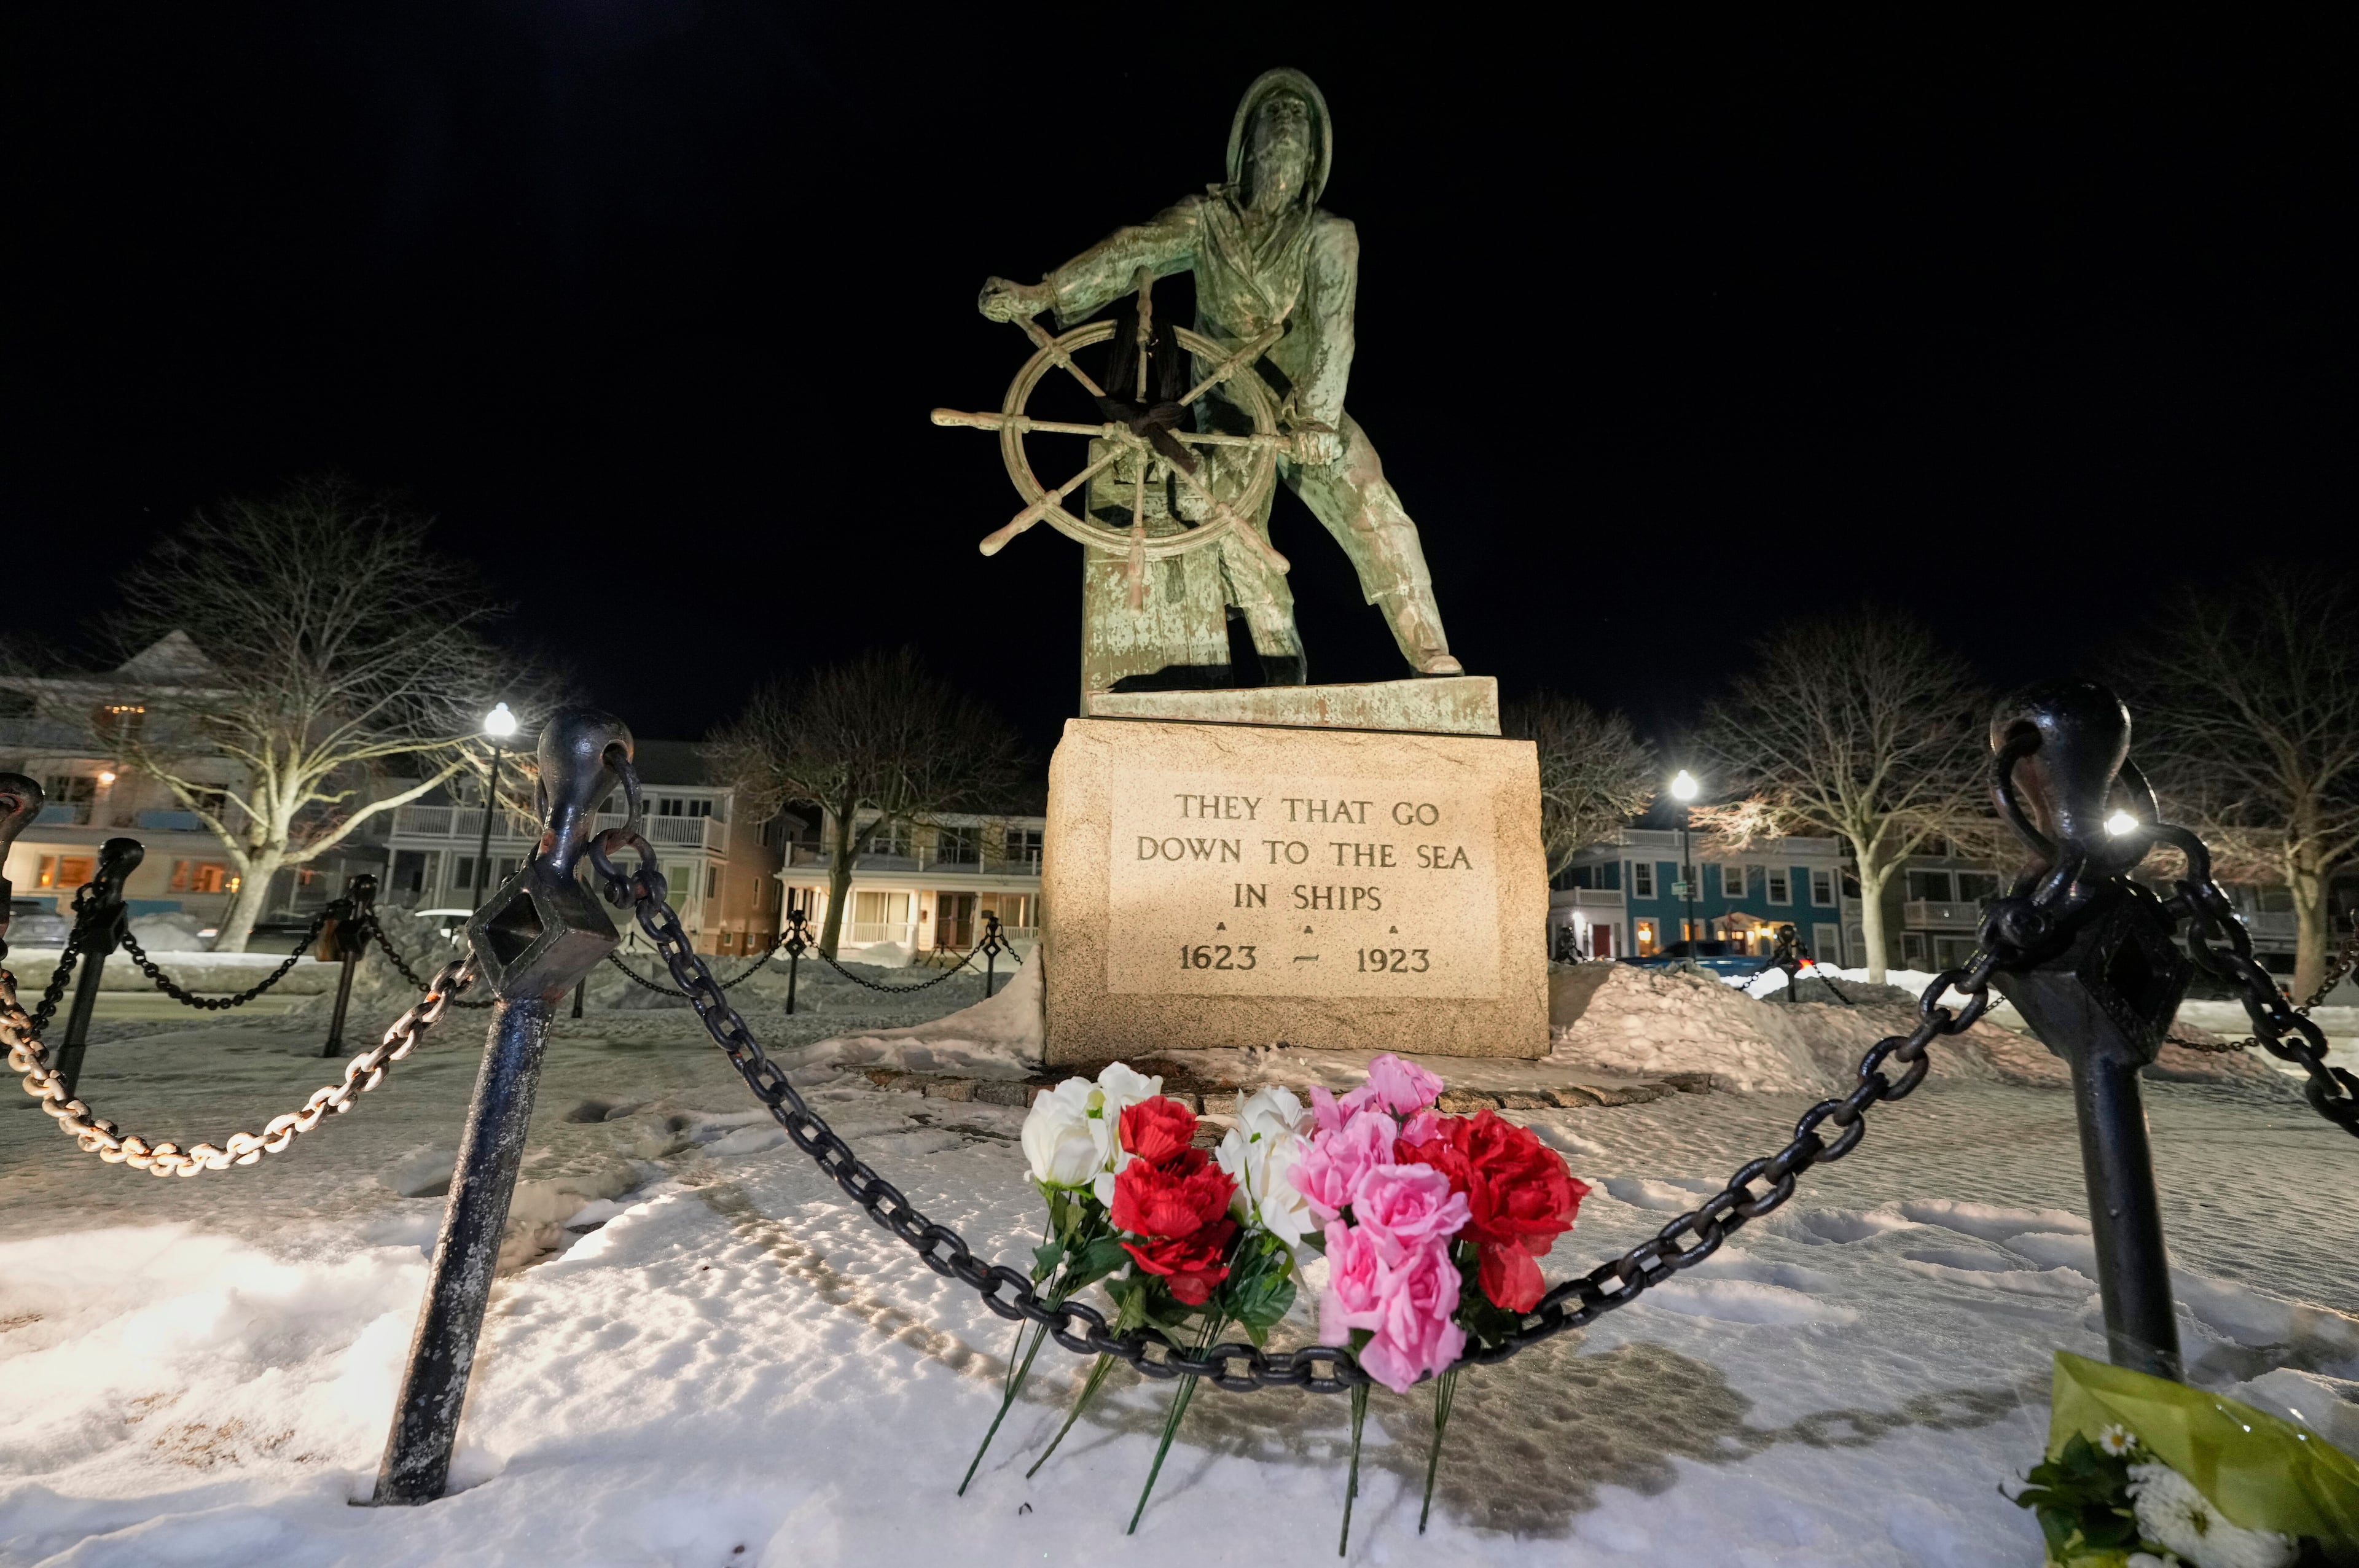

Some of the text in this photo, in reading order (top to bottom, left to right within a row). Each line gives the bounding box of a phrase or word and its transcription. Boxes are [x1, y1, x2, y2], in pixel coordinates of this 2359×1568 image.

[1174, 794, 1439, 826] THEY THAT GO
[1137, 836, 1473, 870] DOWN TO THE SEA
[1234, 883, 1382, 911] IN SHIPS
[1180, 945, 1256, 970] 1623
[1357, 948, 1430, 973] 1923
